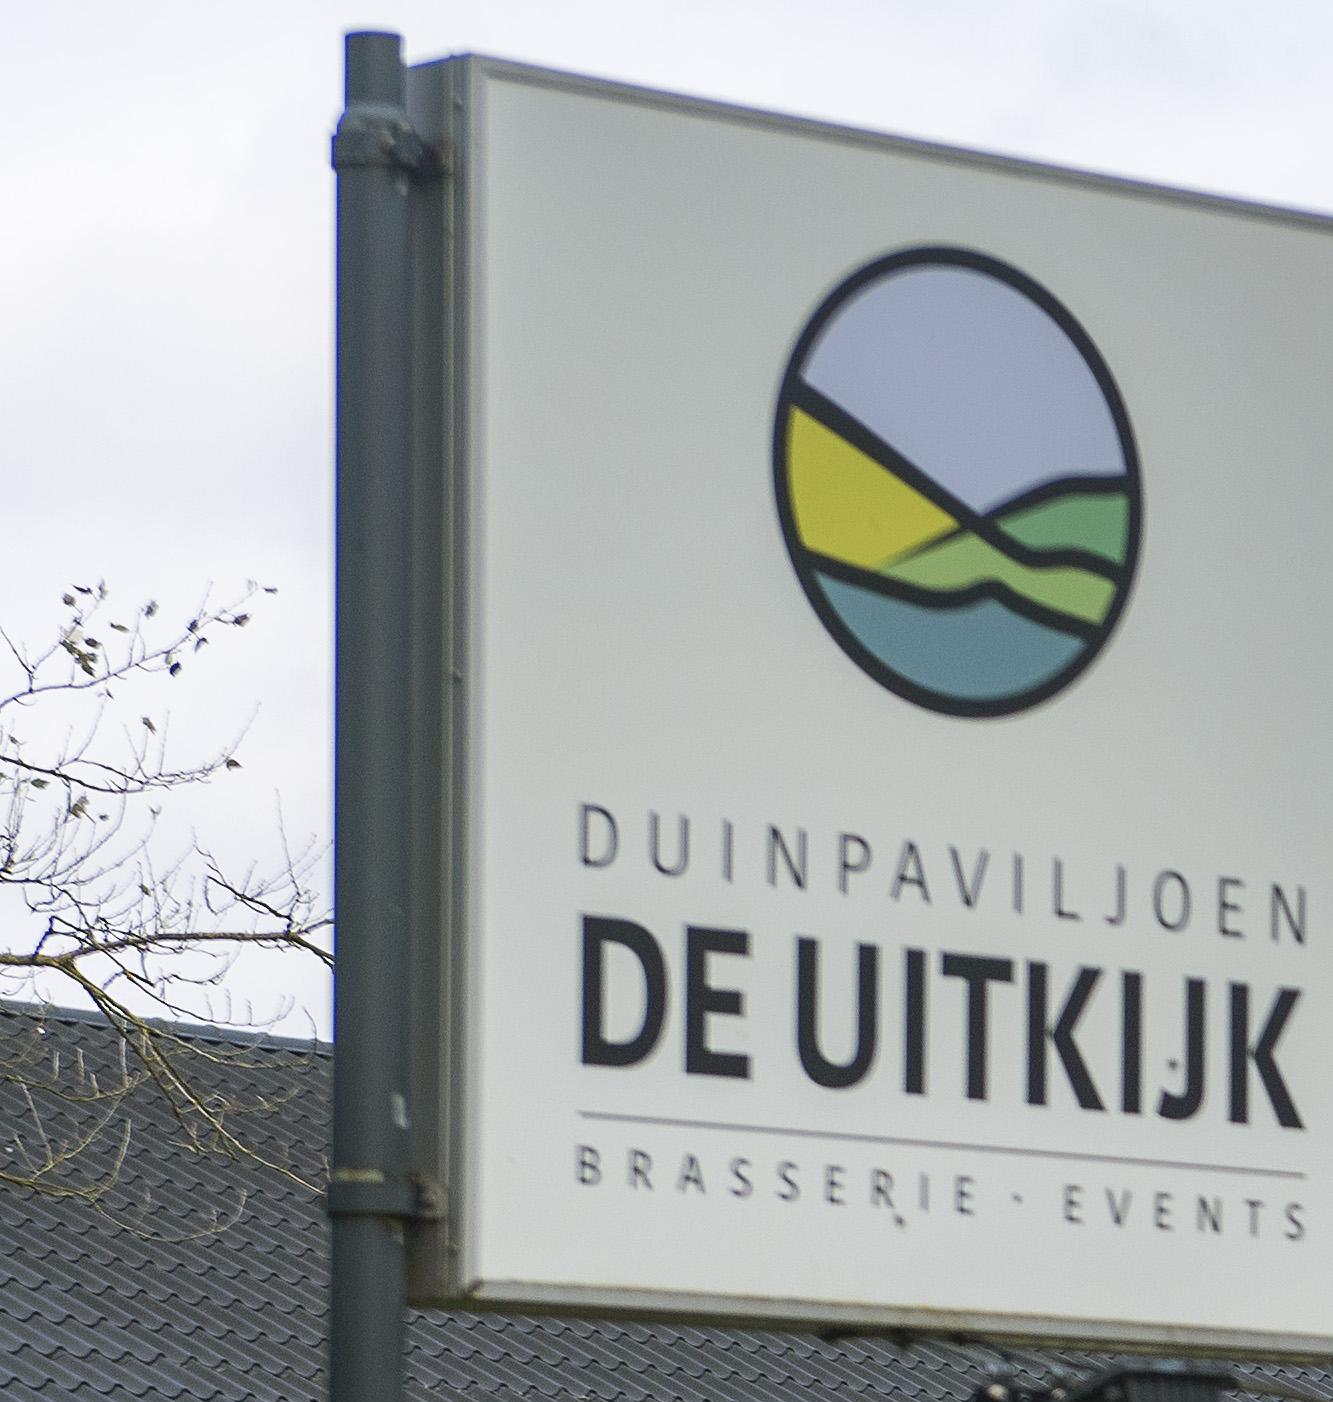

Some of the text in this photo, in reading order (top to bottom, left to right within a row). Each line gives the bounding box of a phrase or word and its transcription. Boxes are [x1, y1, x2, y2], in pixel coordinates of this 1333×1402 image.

[577, 803, 1307, 944] DUINPAVILJOEN
[579, 912, 1306, 1130] DE UITKIJK
[576, 1144, 977, 1216] BRASSERIE
[1062, 1184, 1307, 1242] EVENTS
